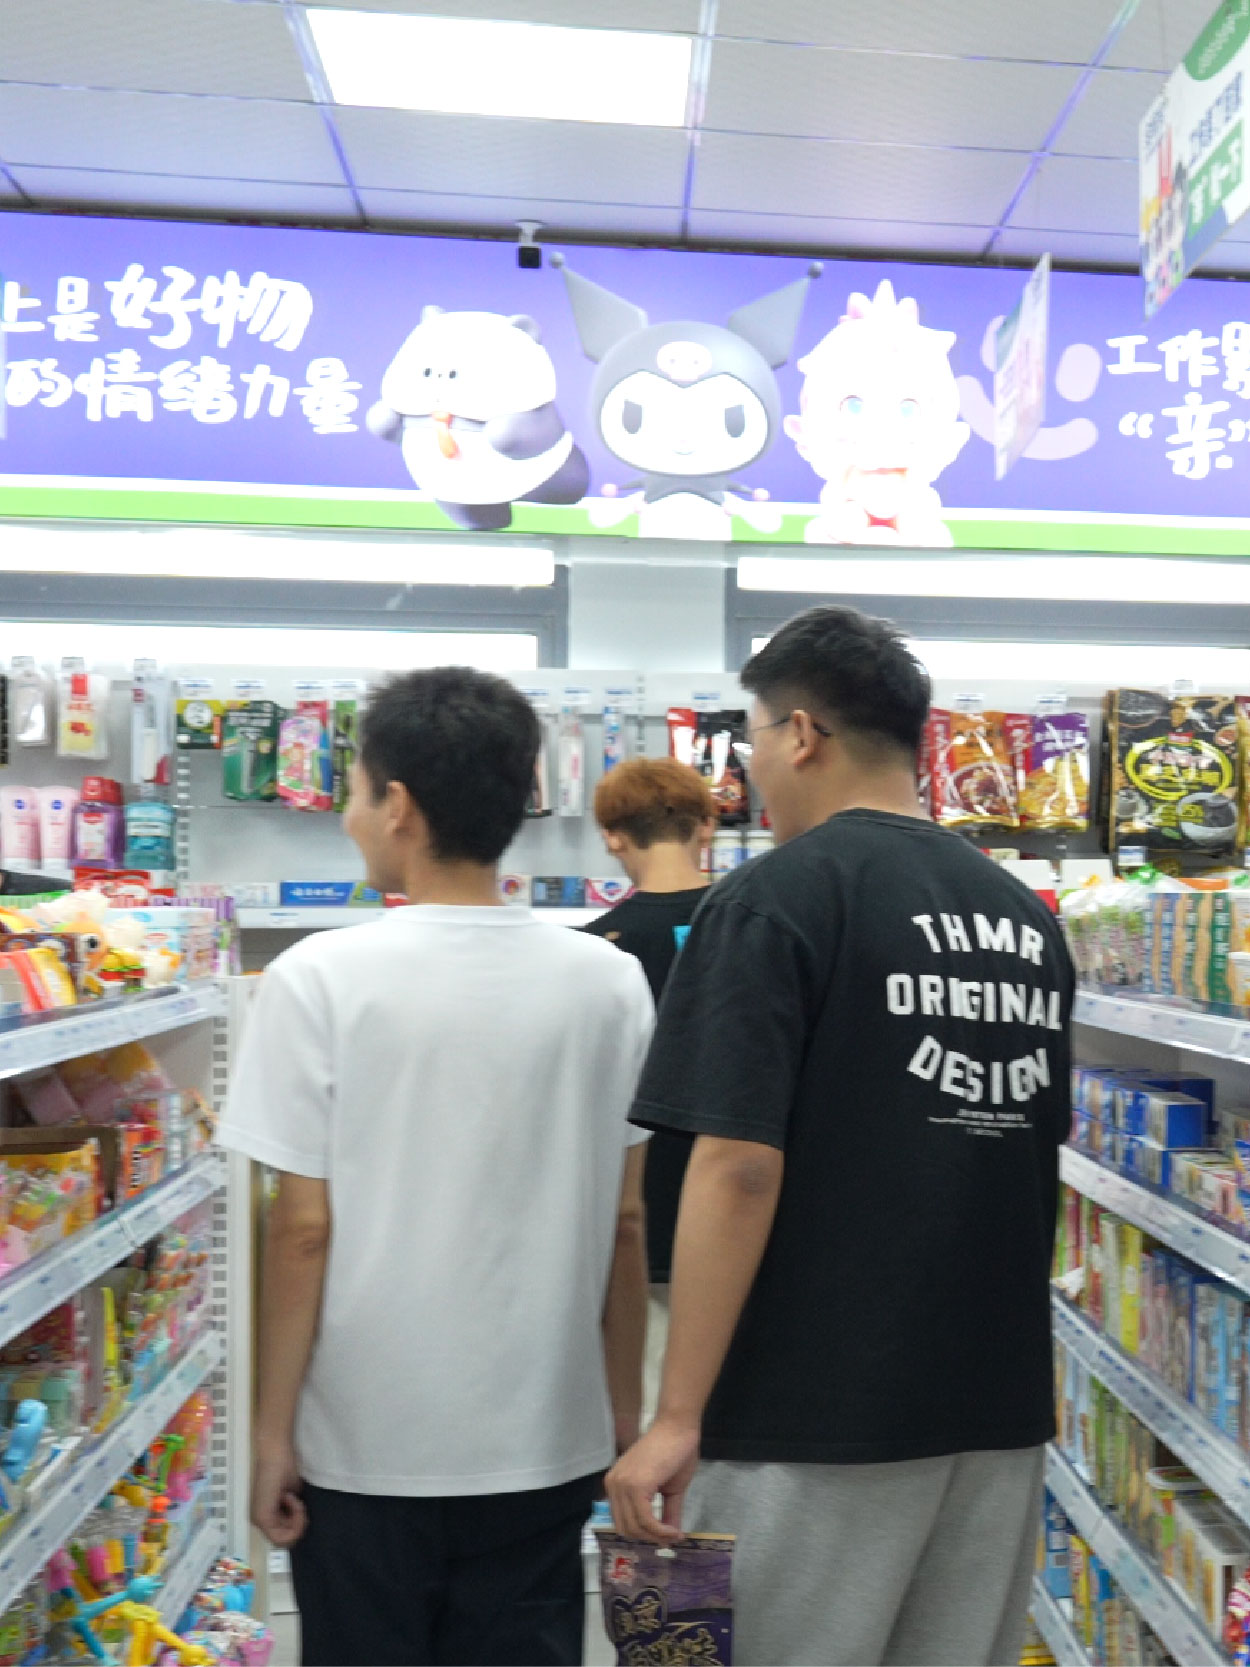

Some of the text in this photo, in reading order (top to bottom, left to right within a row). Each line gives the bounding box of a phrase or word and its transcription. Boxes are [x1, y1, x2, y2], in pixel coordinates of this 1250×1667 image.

[0, 263, 314, 352] 上是好物
[4, 349, 364, 435] 的情绪力量
[911, 912, 1045, 966] THMR
[885, 972, 1063, 1032] ORIGINAL
[906, 1034, 1051, 1105] DESIGN
